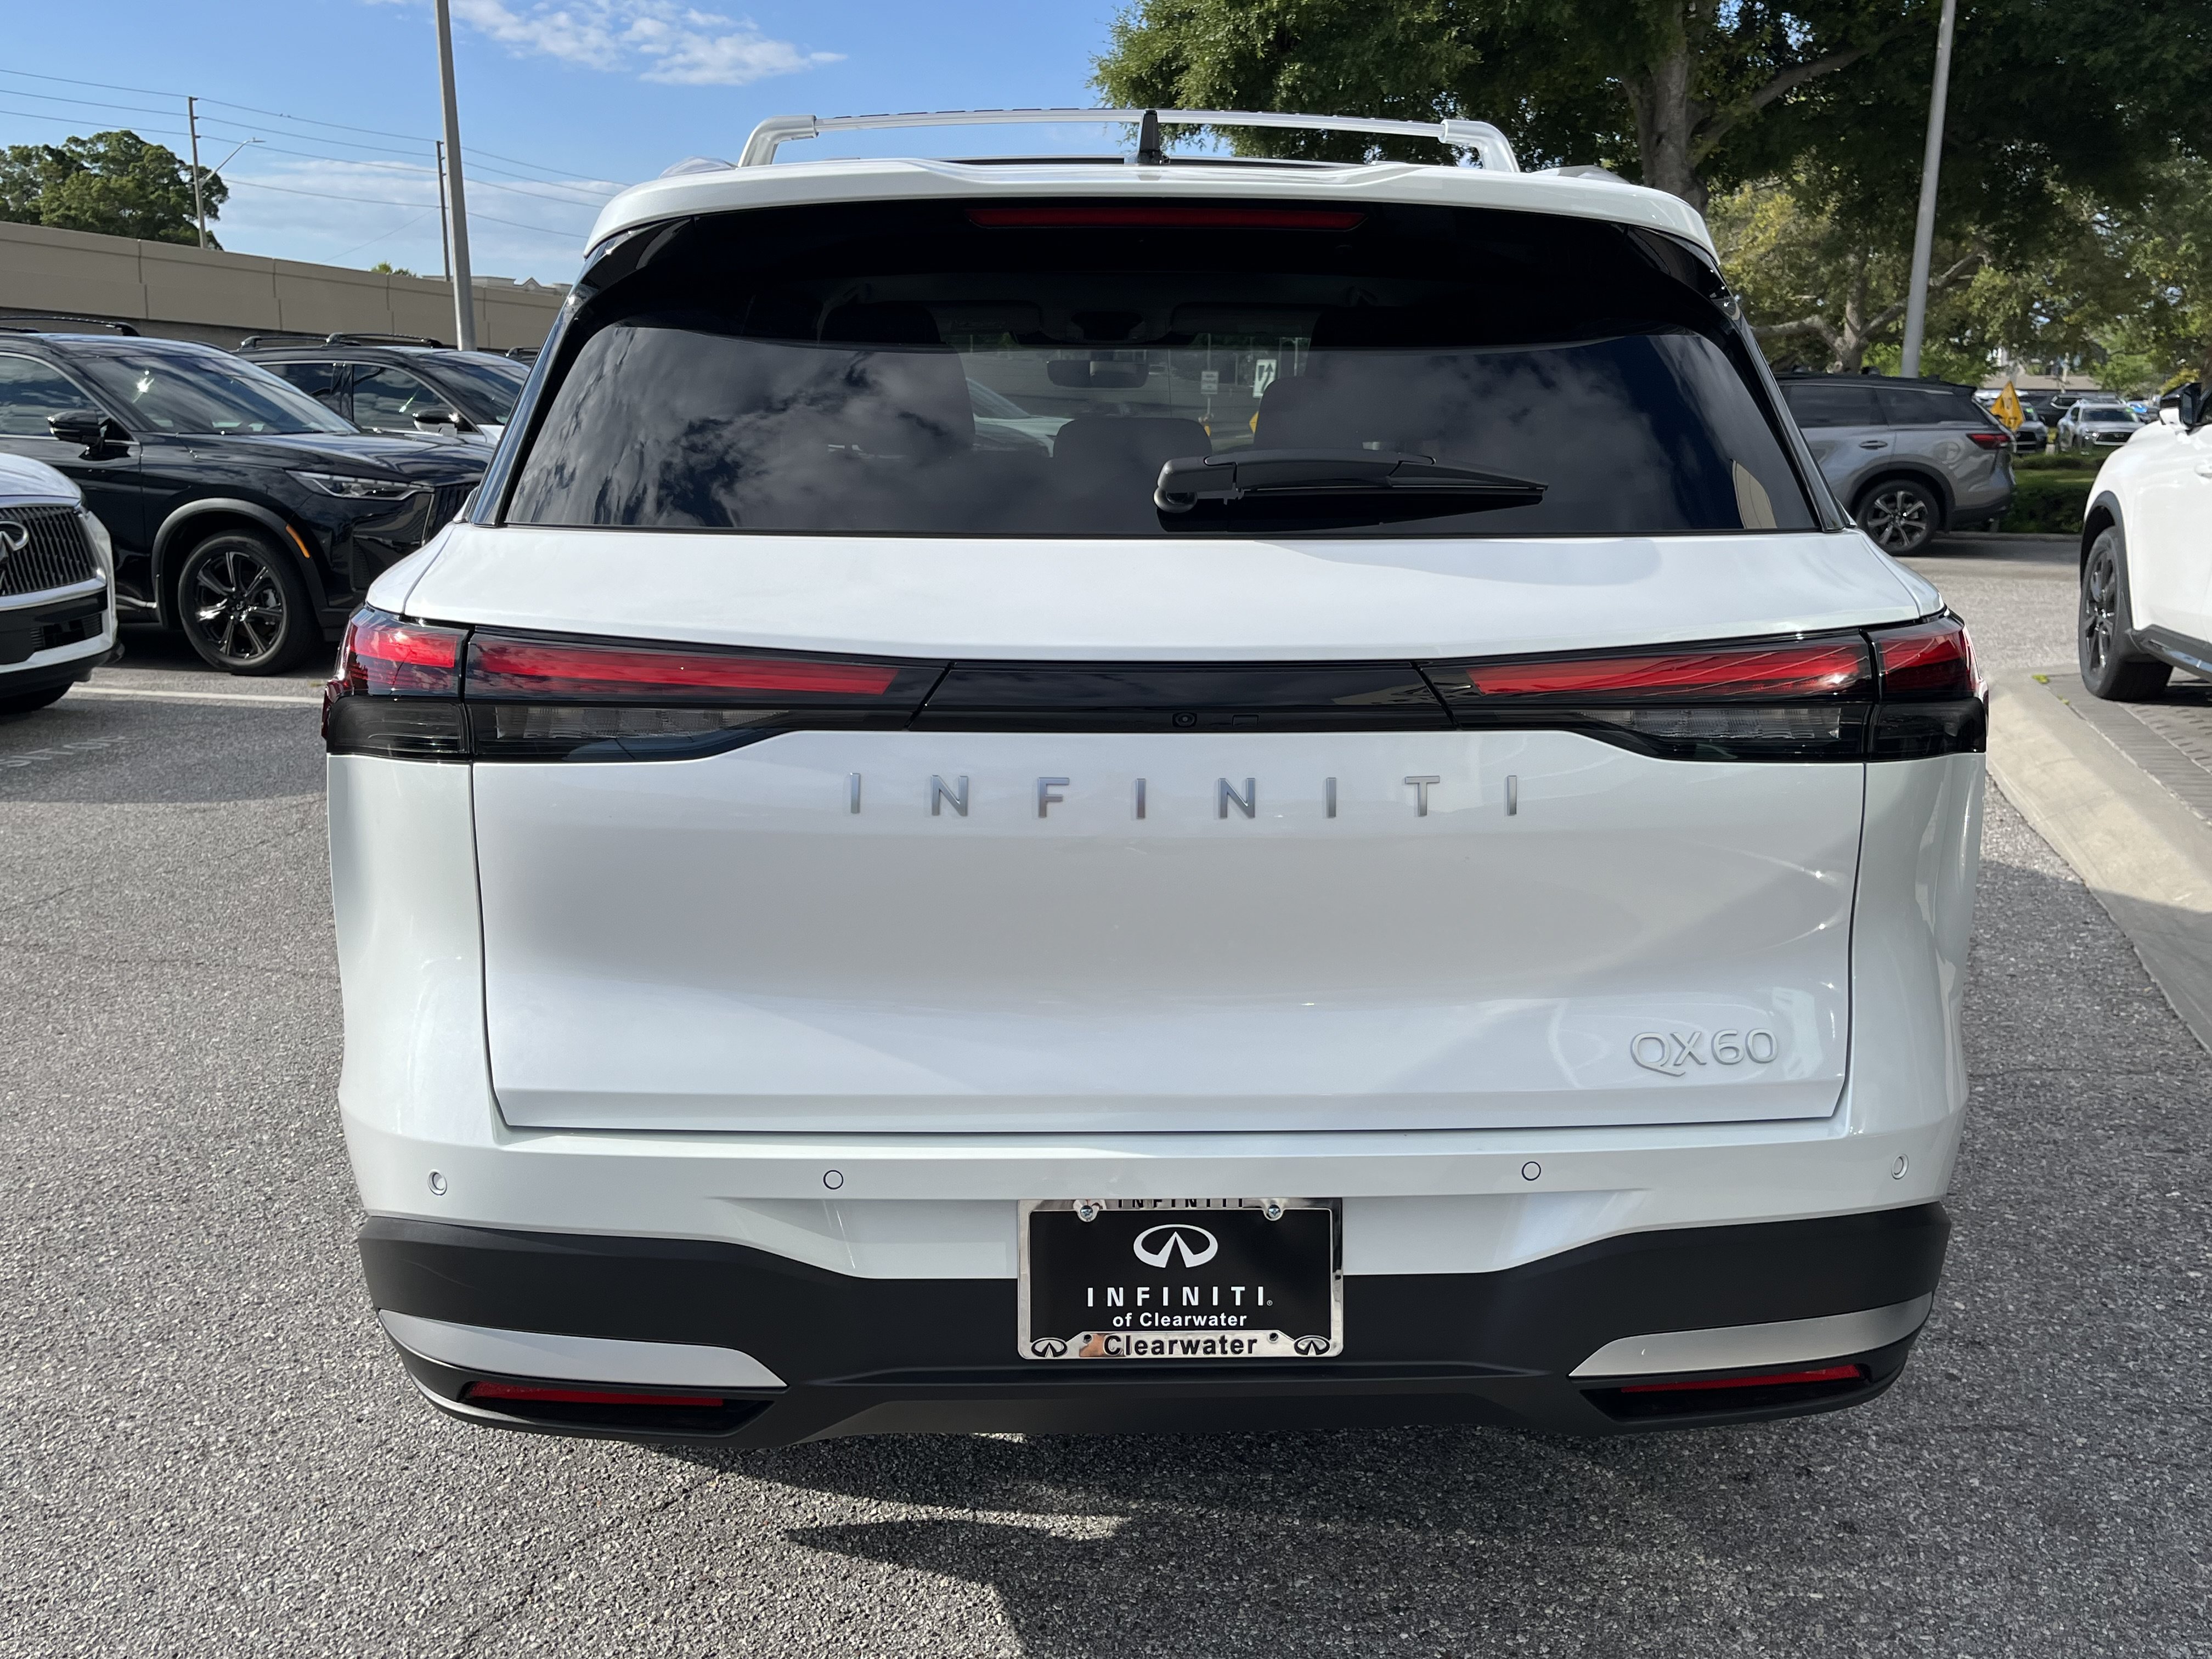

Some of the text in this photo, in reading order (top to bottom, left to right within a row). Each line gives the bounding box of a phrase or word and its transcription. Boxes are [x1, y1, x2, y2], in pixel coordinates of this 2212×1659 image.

[849, 772, 1519, 820] INFINITI
[1630, 1027, 1779, 1077] QX60
[1087, 1285, 1264, 1307] INFINITI
[1112, 1311, 1248, 1328] of Clearwater
[1104, 1334, 1258, 1356] Clearwater
